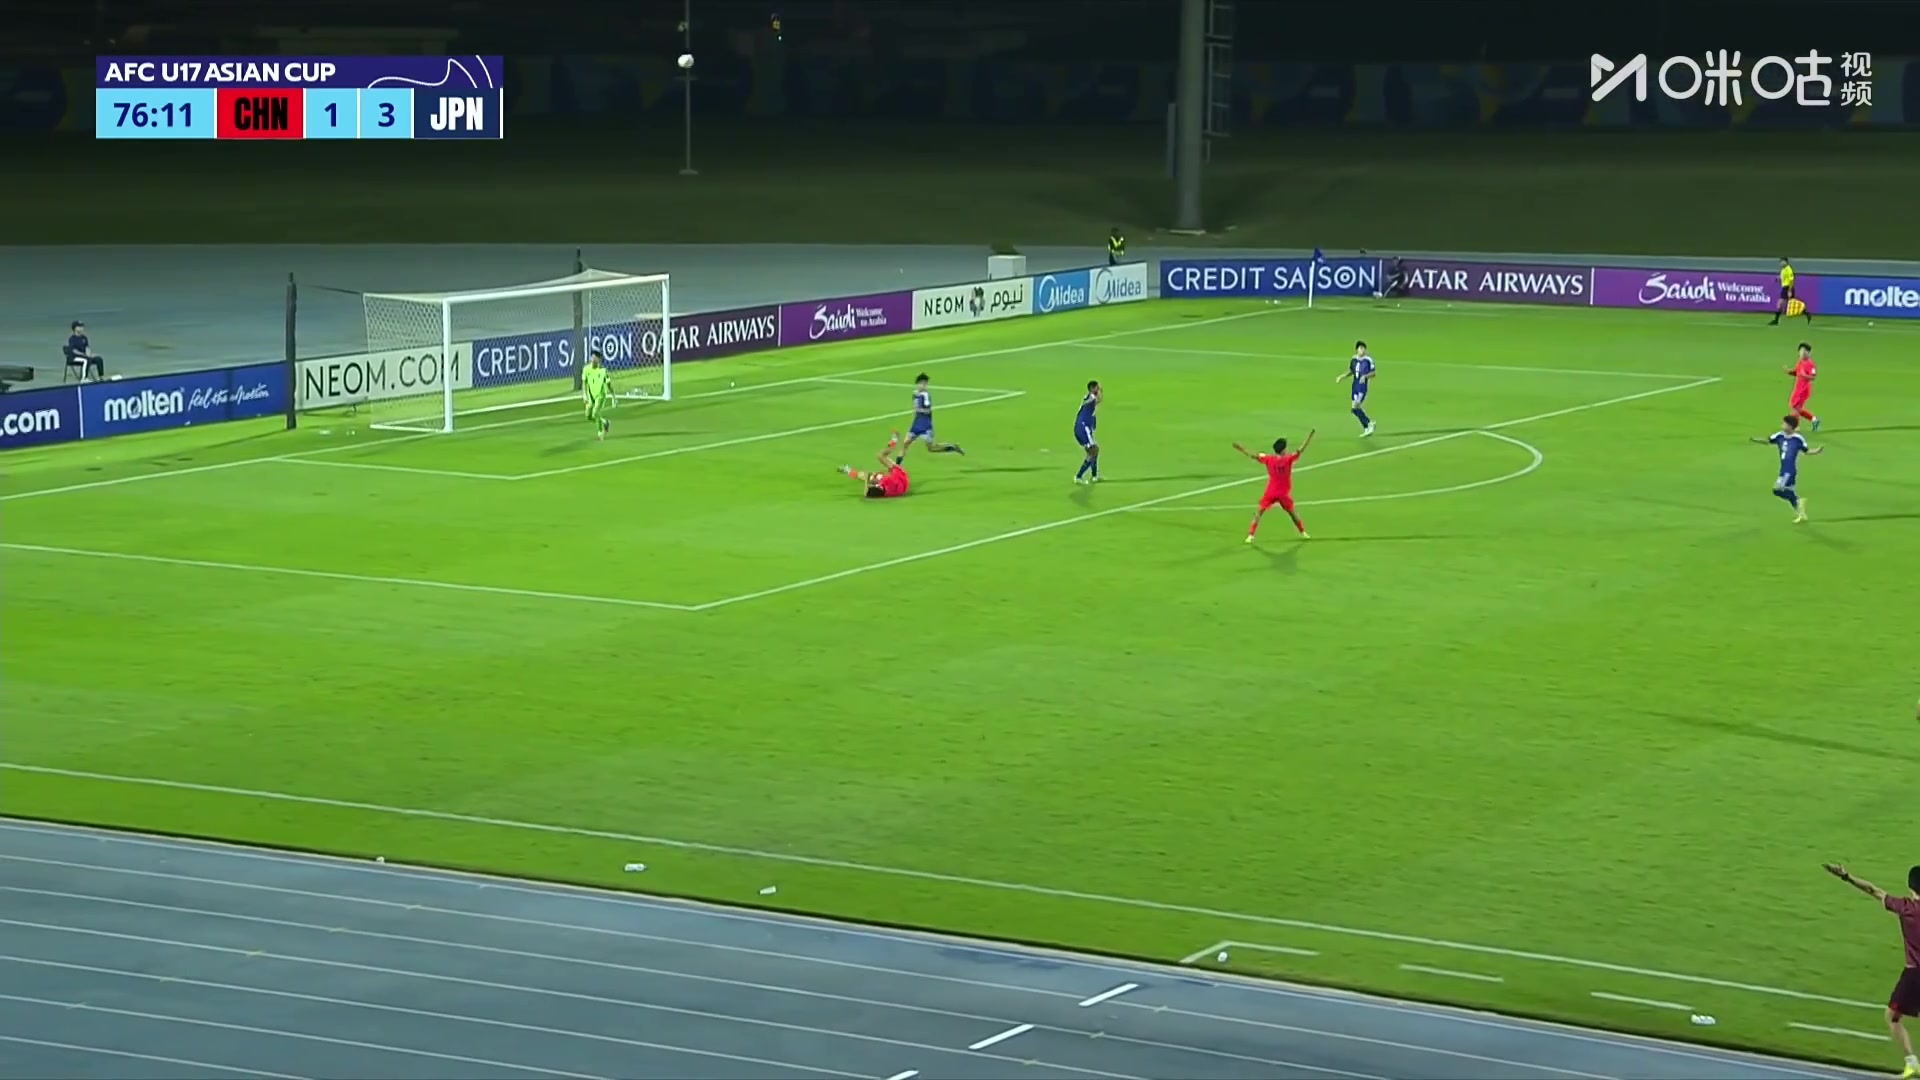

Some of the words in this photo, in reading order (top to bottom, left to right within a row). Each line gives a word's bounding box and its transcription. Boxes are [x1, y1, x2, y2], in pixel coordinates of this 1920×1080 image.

[1100, 272, 1142, 302] Midea
[1167, 266, 1266, 291] CREDIT
[1273, 266, 1376, 291] SASON
[1479, 271, 1584, 296] AIRWAYS
[1638, 272, 1717, 304] Saudi
[1717, 282, 1764, 294] Welcome
[923, 294, 965, 317] NEOM
[1044, 280, 1085, 309] Midea
[1725, 292, 1736, 302] to
[1738, 292, 1771, 304] Arabia
[1844, 285, 1920, 308] molte
[707, 314, 775, 347] AIRWAYS
[809, 303, 856, 340] Saudi
[477, 341, 553, 377] CREDIT
[558, 333, 632, 367] SISON
[305, 350, 460, 401] NEOM.COM
[104, 390, 183, 422] molten
